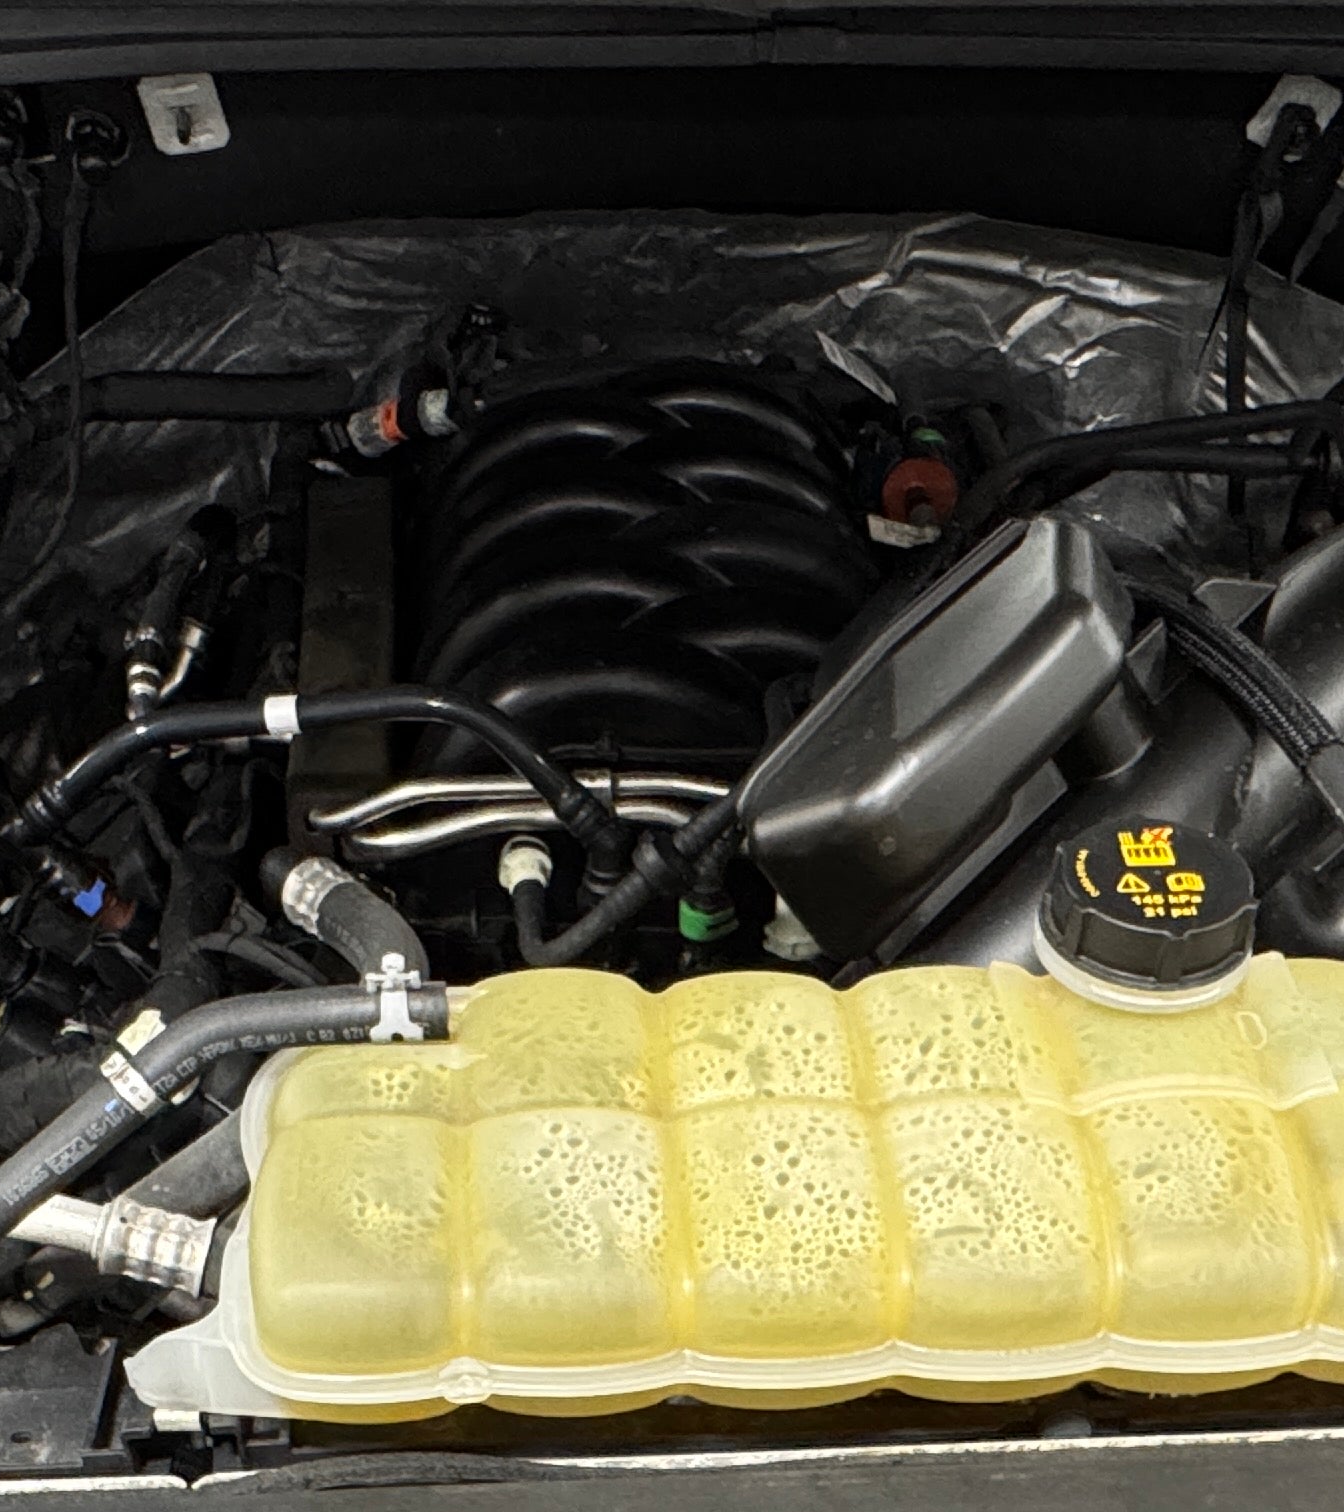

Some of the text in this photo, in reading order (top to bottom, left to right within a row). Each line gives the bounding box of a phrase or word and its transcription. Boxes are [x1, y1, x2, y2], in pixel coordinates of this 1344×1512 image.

[1131, 894, 1203, 906] 145 kPa
[1170, 905, 1199, 919] psi
